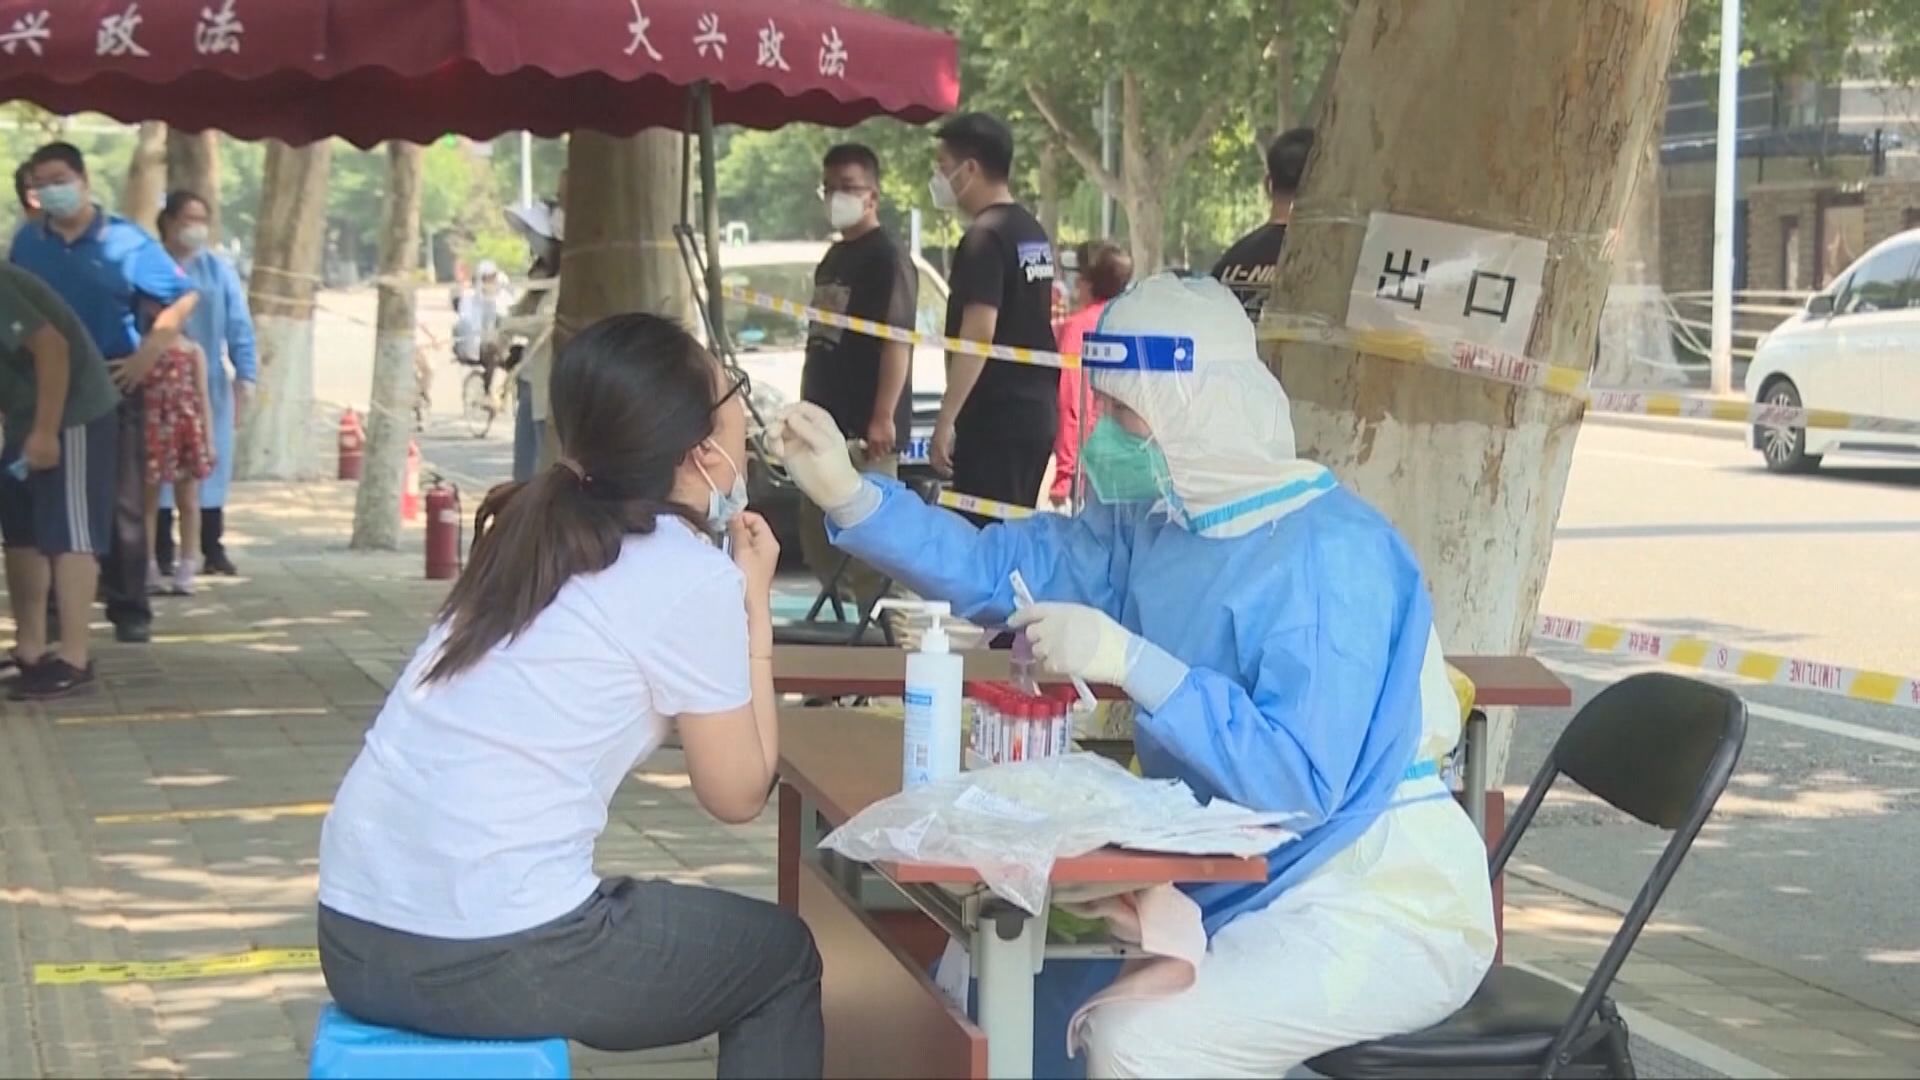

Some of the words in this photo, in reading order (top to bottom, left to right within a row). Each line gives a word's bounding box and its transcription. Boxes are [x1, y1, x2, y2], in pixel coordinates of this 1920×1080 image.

[623, 0, 849, 80] 大兴政法
[1376, 249, 1517, 323] 出口
[1789, 659, 1842, 690] LIMITLINE
